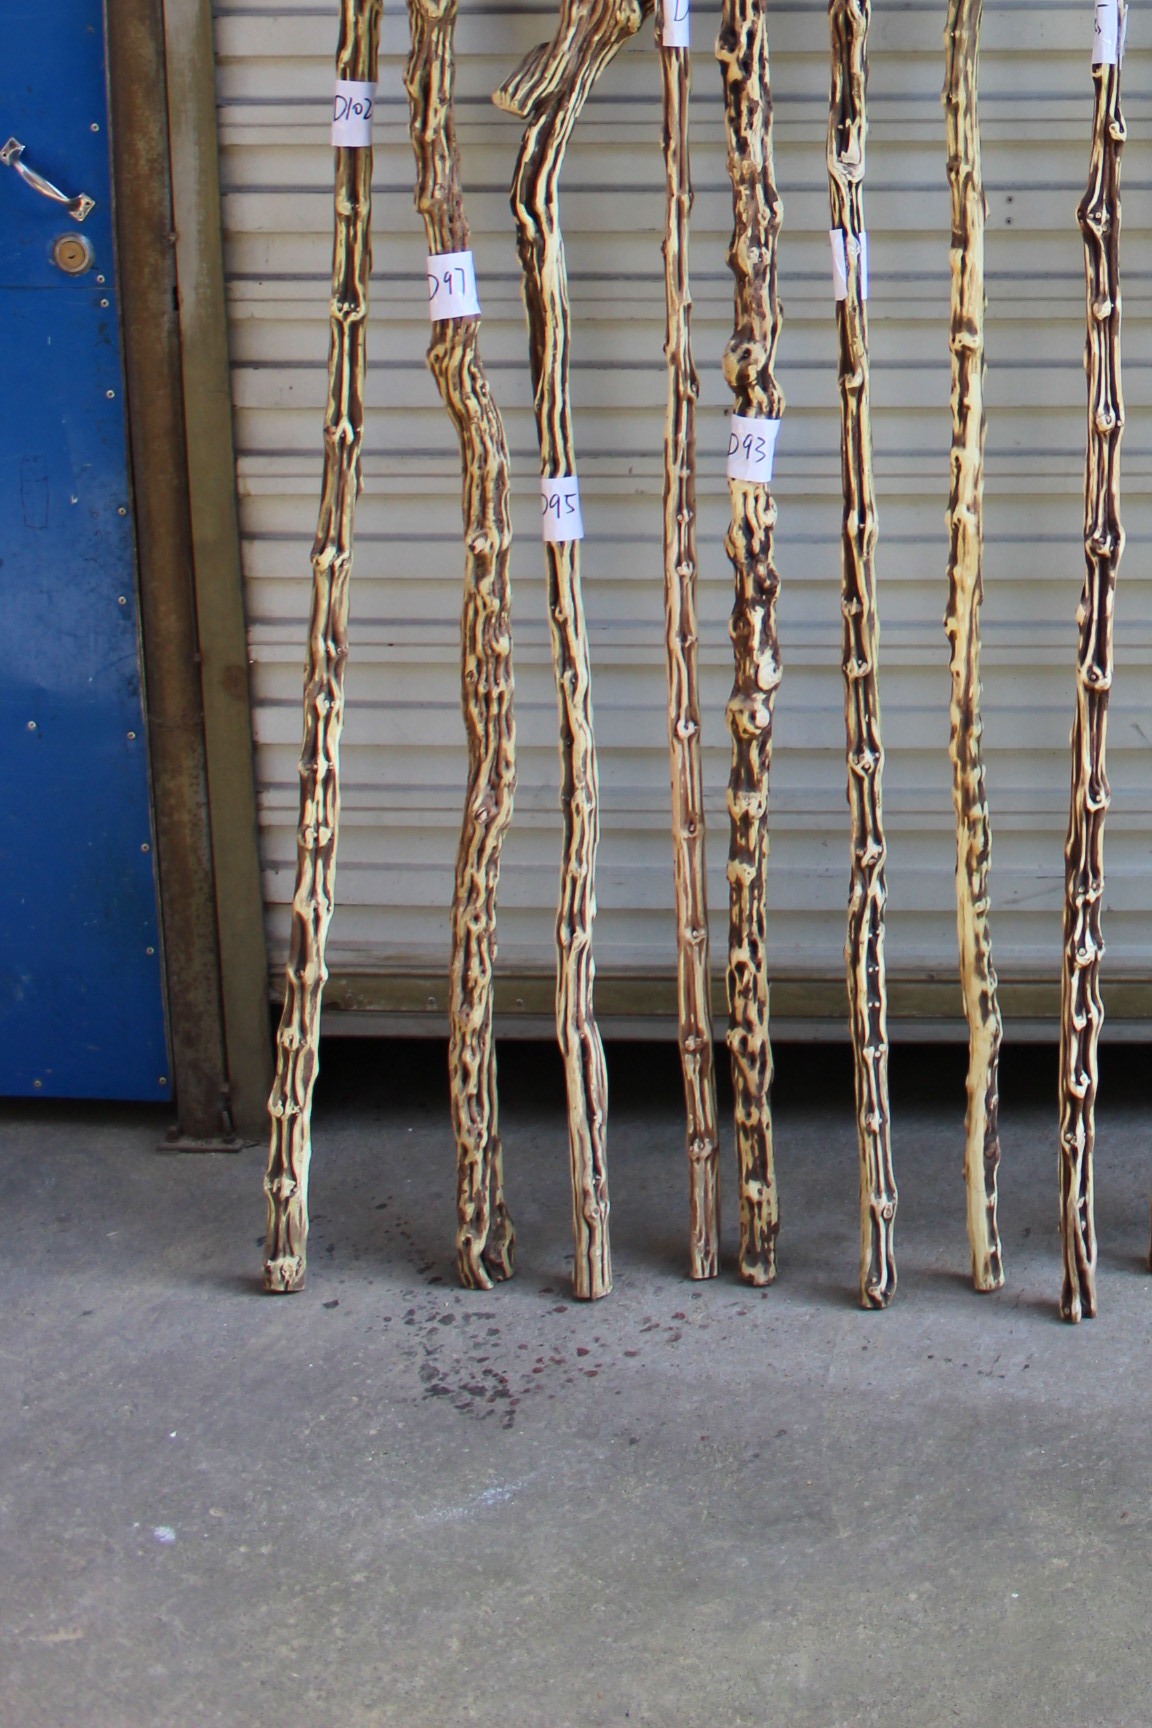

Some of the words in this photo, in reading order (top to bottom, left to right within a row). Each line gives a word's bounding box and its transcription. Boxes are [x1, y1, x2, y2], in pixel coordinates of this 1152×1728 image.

[333, 94, 373, 122] D102
[428, 267, 466, 301] D97
[728, 433, 766, 463] D93
